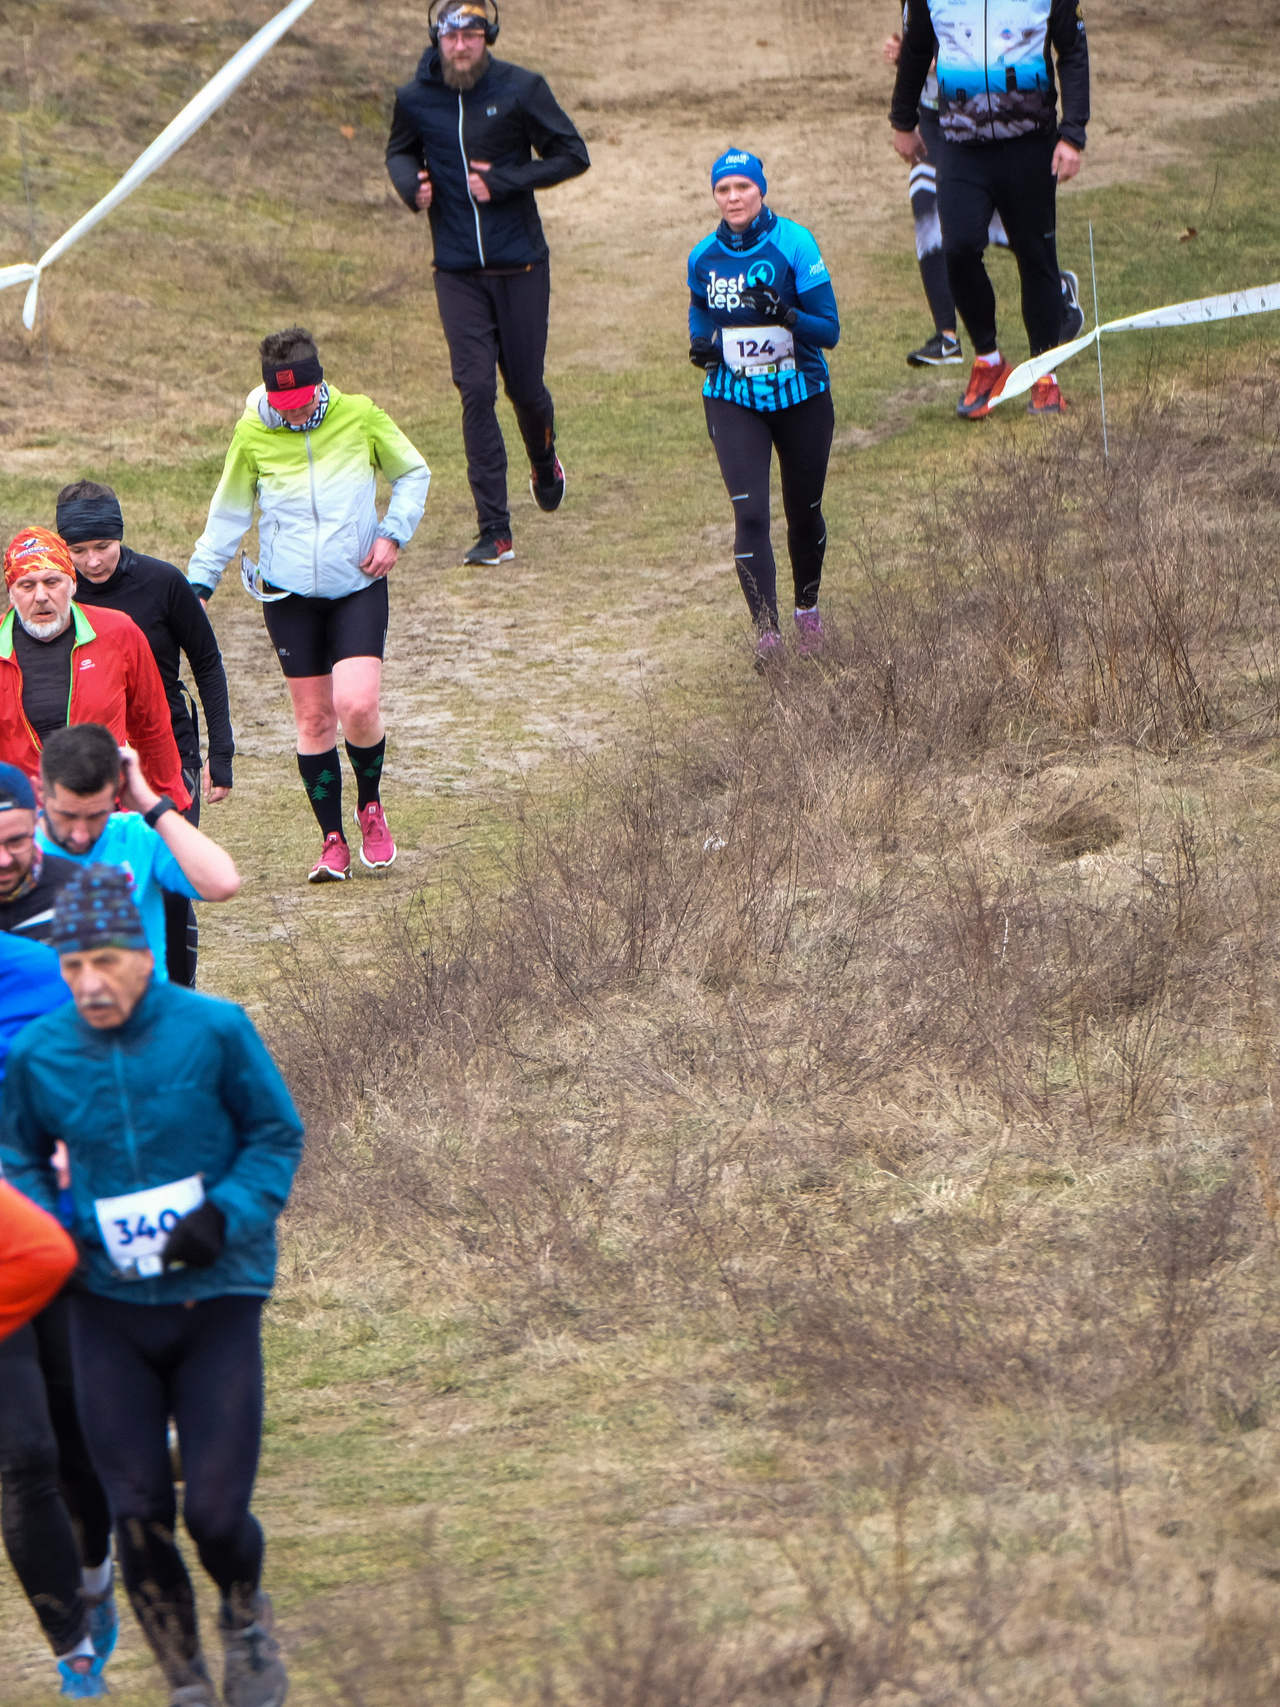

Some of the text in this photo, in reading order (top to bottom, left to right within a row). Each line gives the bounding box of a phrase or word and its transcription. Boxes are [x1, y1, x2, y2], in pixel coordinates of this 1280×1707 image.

[706, 284, 746, 313] Lep
[708, 271, 745, 298] Jest
[736, 339, 776, 358] 124
[114, 1208, 181, 1246] 340
